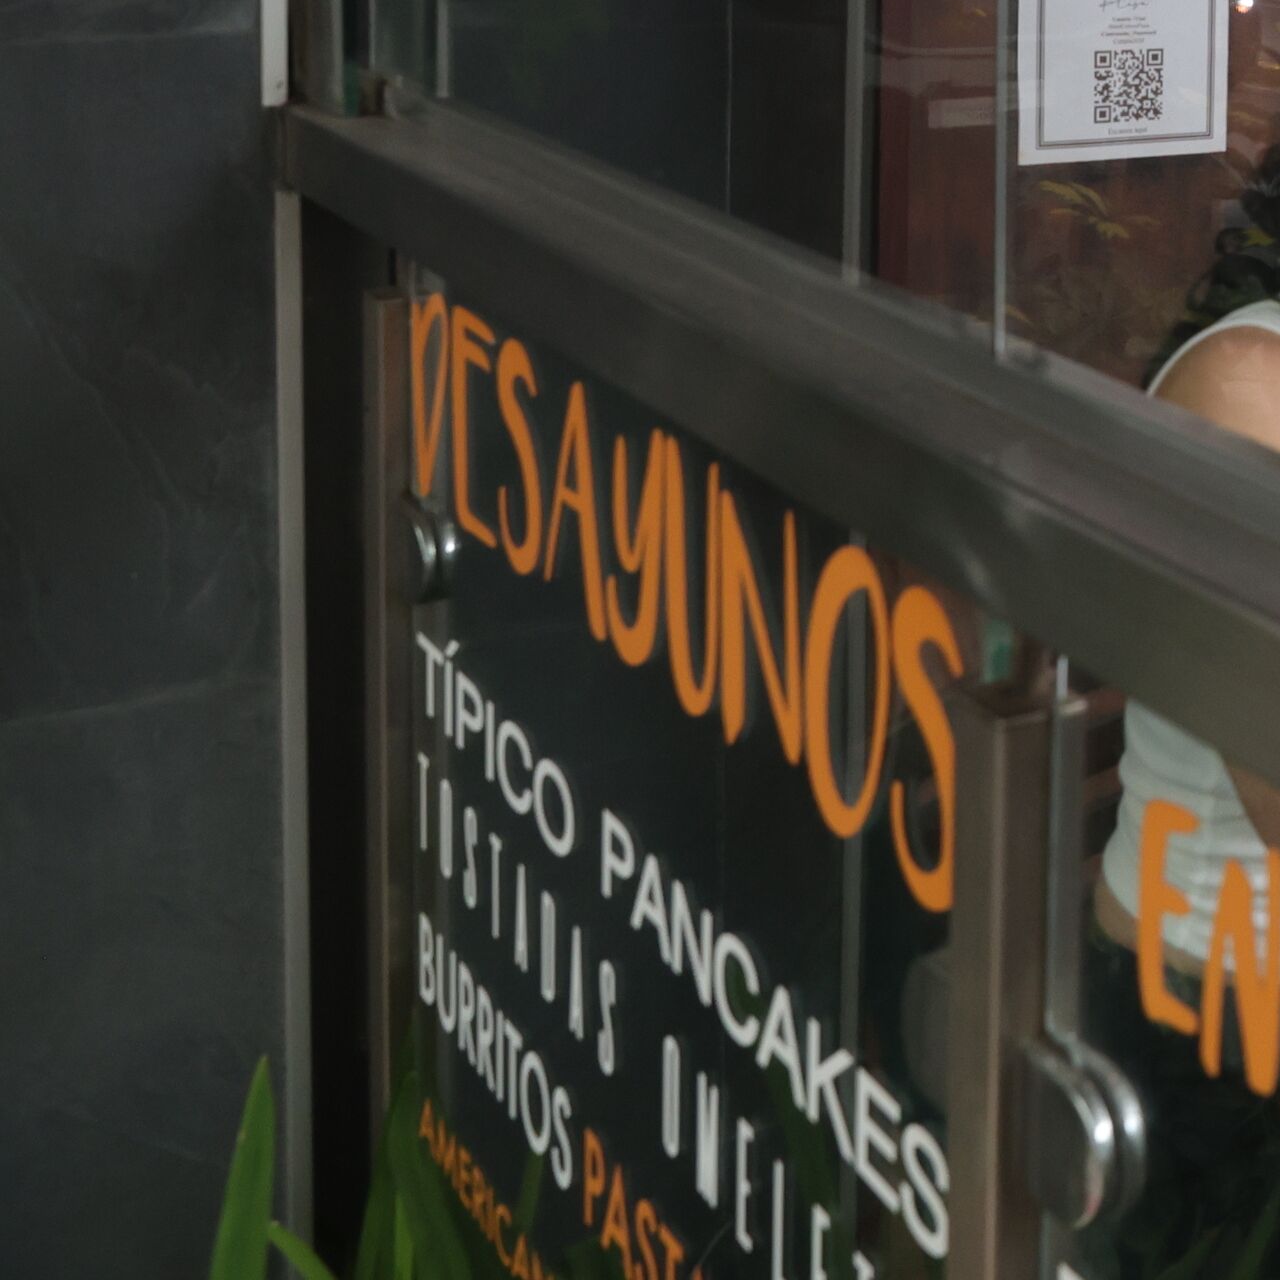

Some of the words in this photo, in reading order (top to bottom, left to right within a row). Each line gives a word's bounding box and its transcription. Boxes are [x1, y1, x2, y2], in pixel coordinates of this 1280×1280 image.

[410, 291, 963, 912] DESAYUNOS
[416, 630, 575, 857] TÍPICO
[602, 809, 950, 1259] PANCAKES
[417, 751, 616, 1076] TOSTADAS
[661, 1034, 875, 1280] OMELE
[418, 912, 572, 1190] BURRITOS
[582, 1126, 706, 1280] PAST
